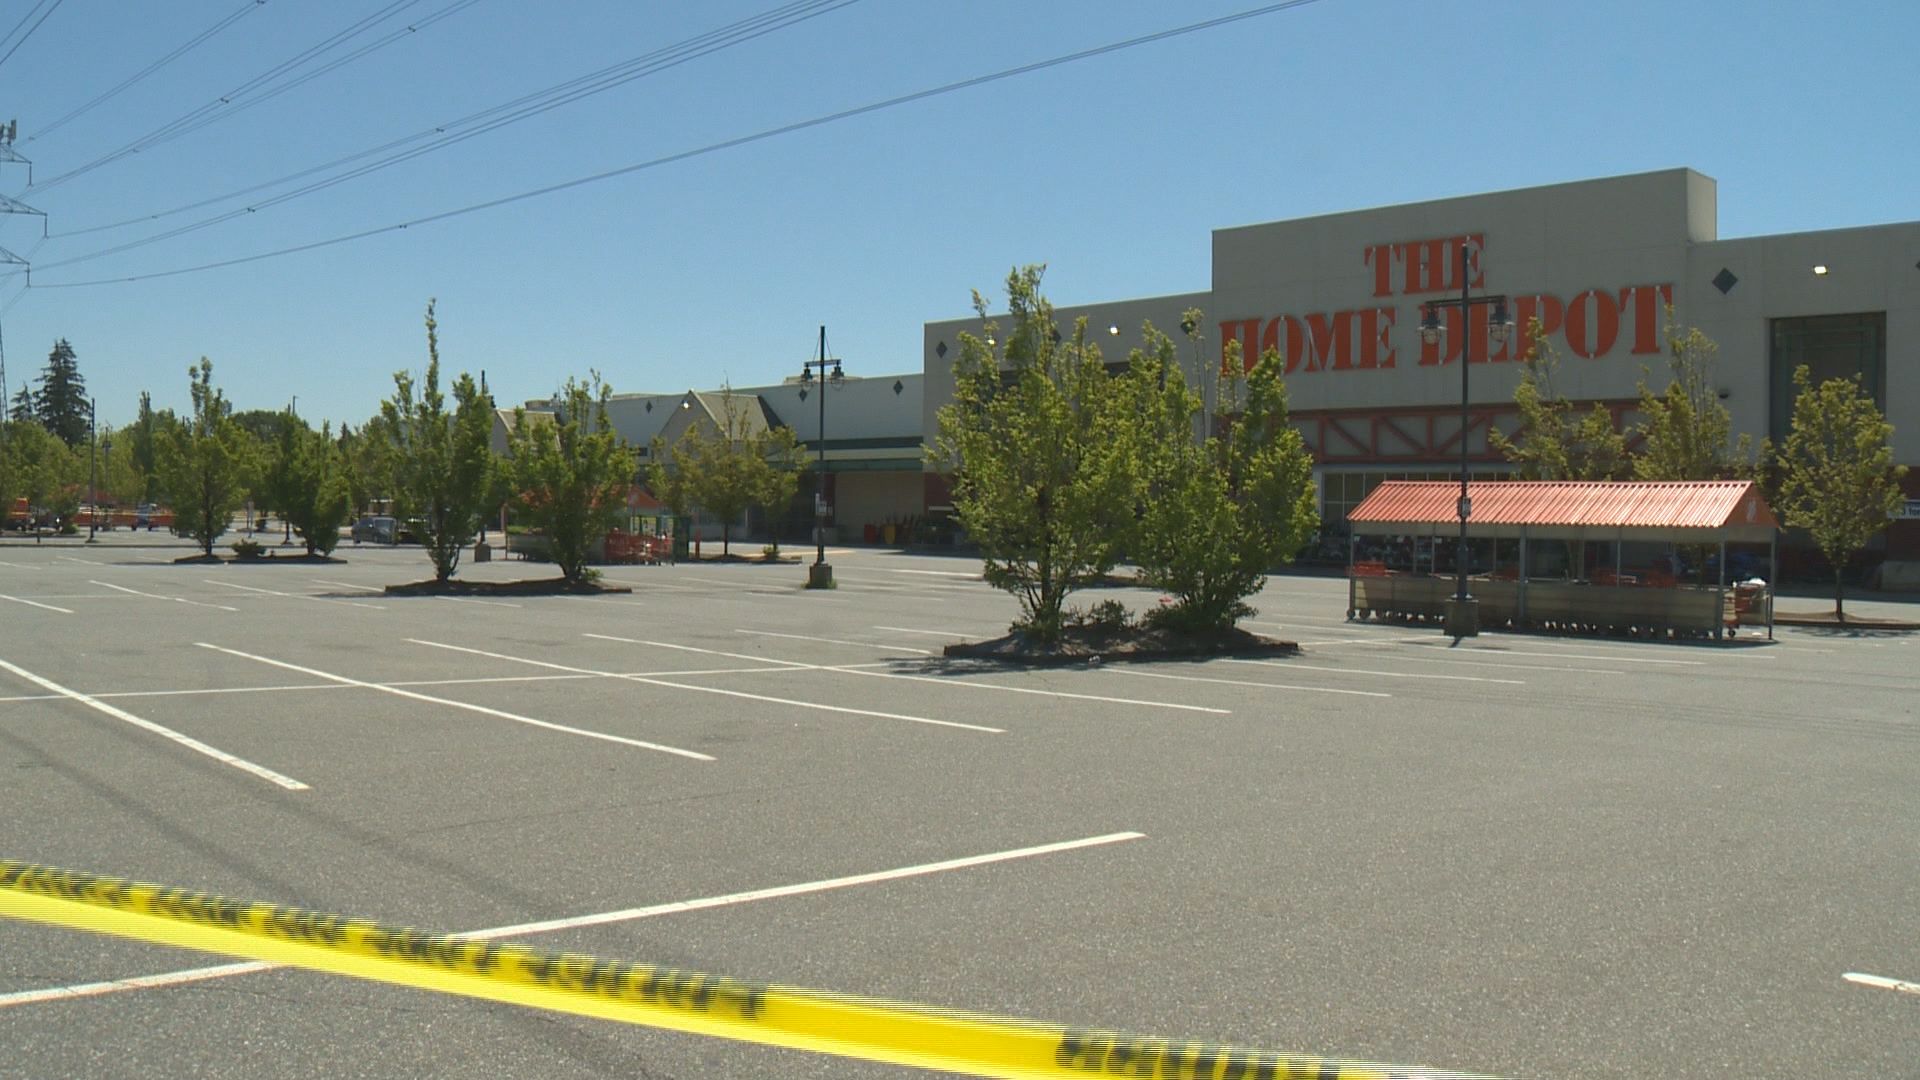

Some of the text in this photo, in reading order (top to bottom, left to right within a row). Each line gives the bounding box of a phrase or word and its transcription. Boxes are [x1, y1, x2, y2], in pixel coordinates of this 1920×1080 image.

[1364, 233, 1486, 297] THE
[1218, 282, 1676, 377] HOME DEPOT
